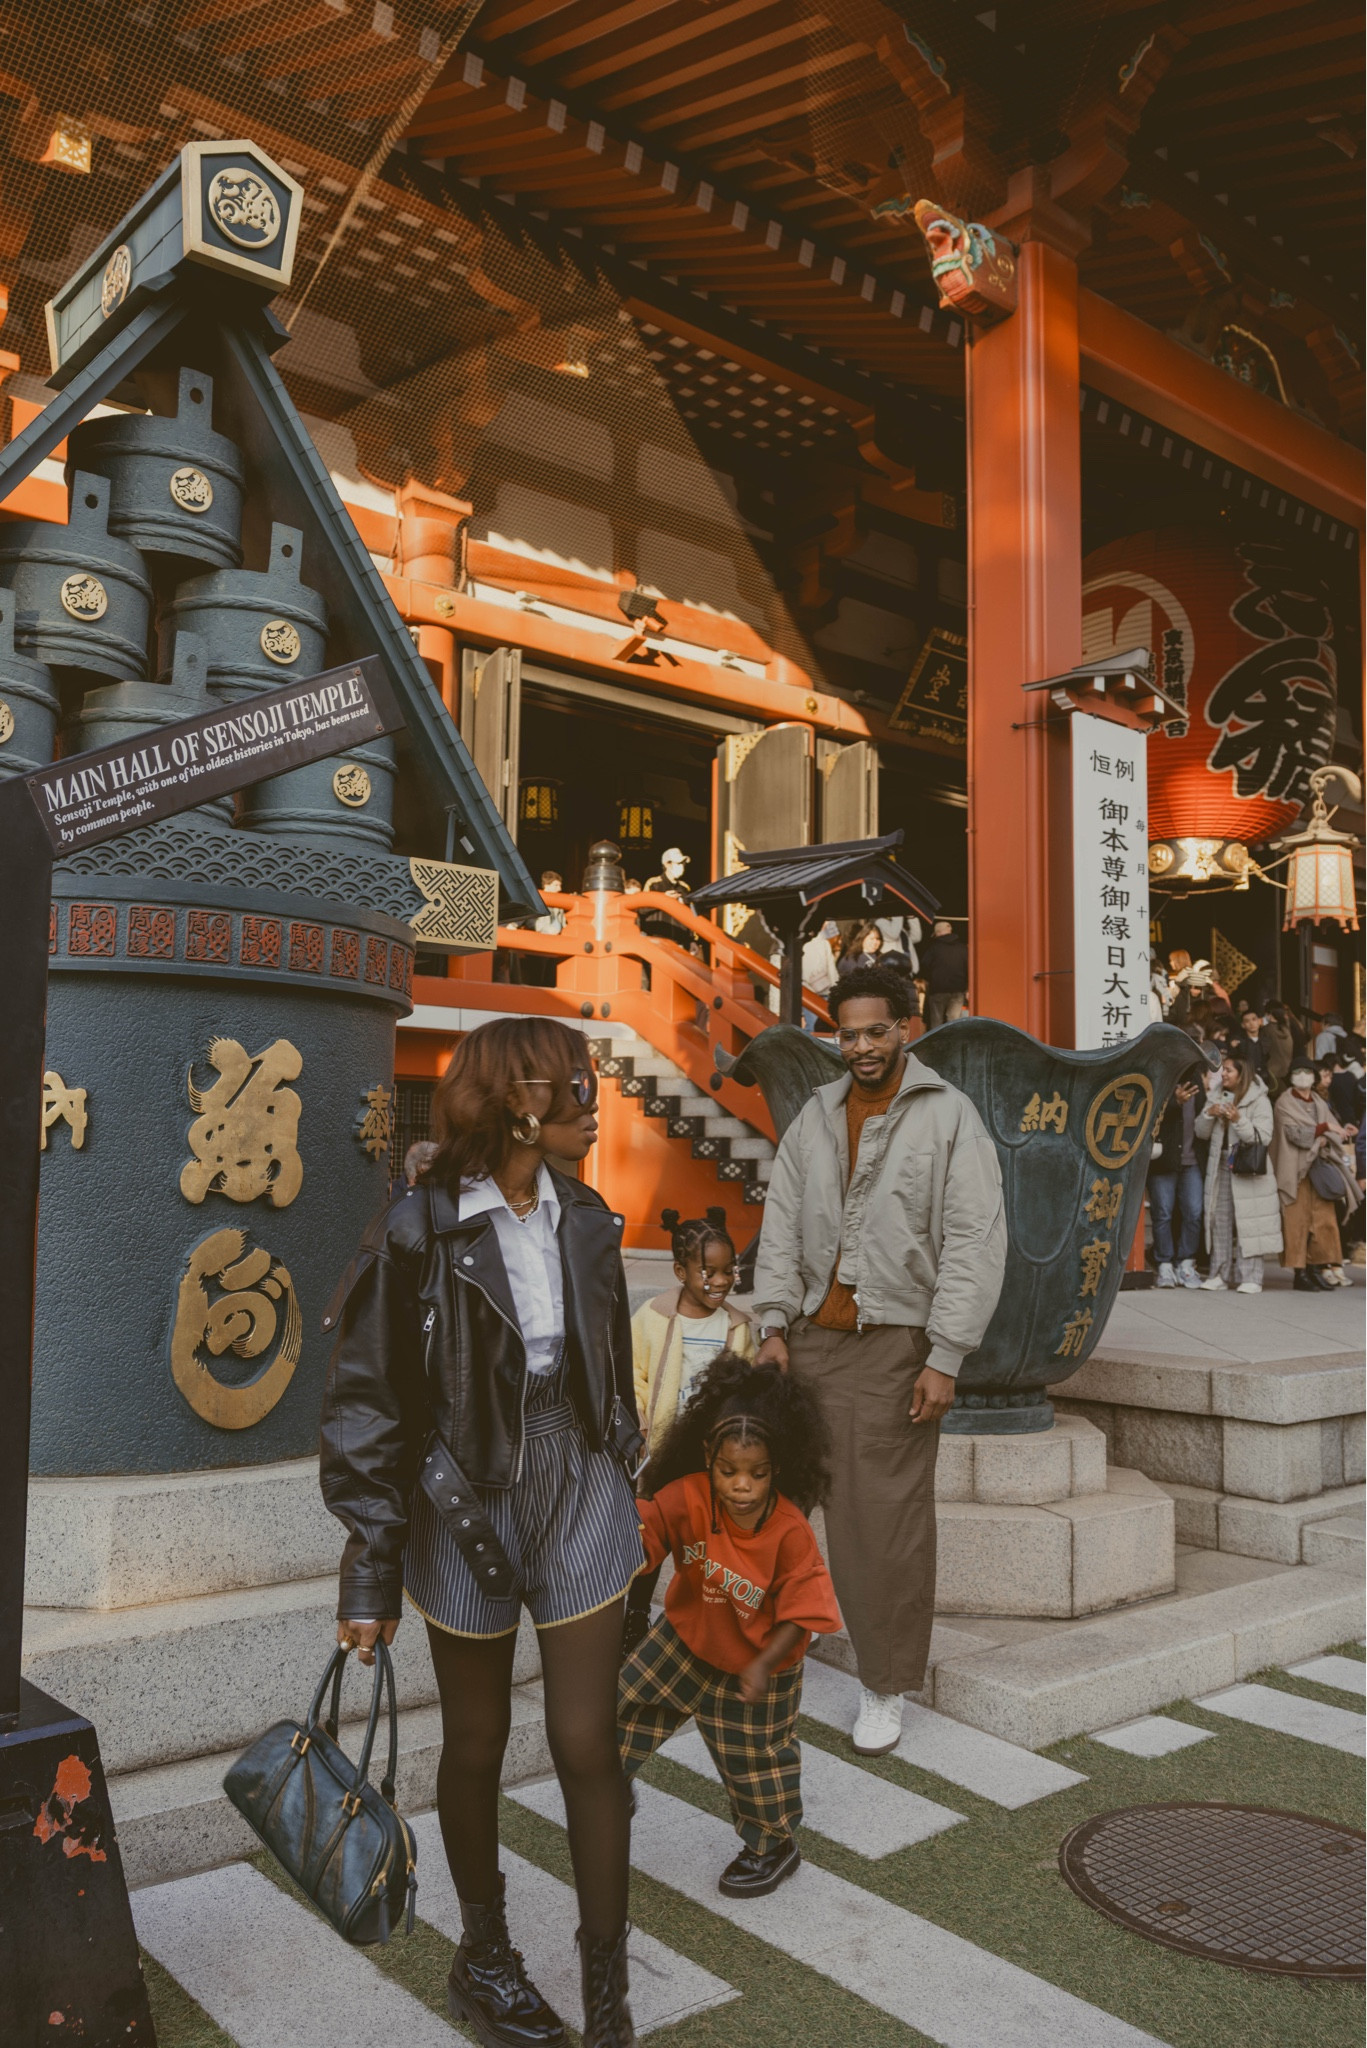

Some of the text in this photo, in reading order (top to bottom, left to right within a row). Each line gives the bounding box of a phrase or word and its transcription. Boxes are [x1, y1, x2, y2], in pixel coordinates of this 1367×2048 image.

[1162, 628, 1188, 738] 東京新橋合
[42, 677, 364, 813] MAIN HALL OF SENSOJI TEMPLE
[54, 703, 370, 826] Sensoji Temple, with one of the oldest histories in Tokyo, has been used
[1090, 749, 1135, 783] 恒例
[60, 799, 156, 842] by common people.
[1020, 1091, 1069, 1134] 納
